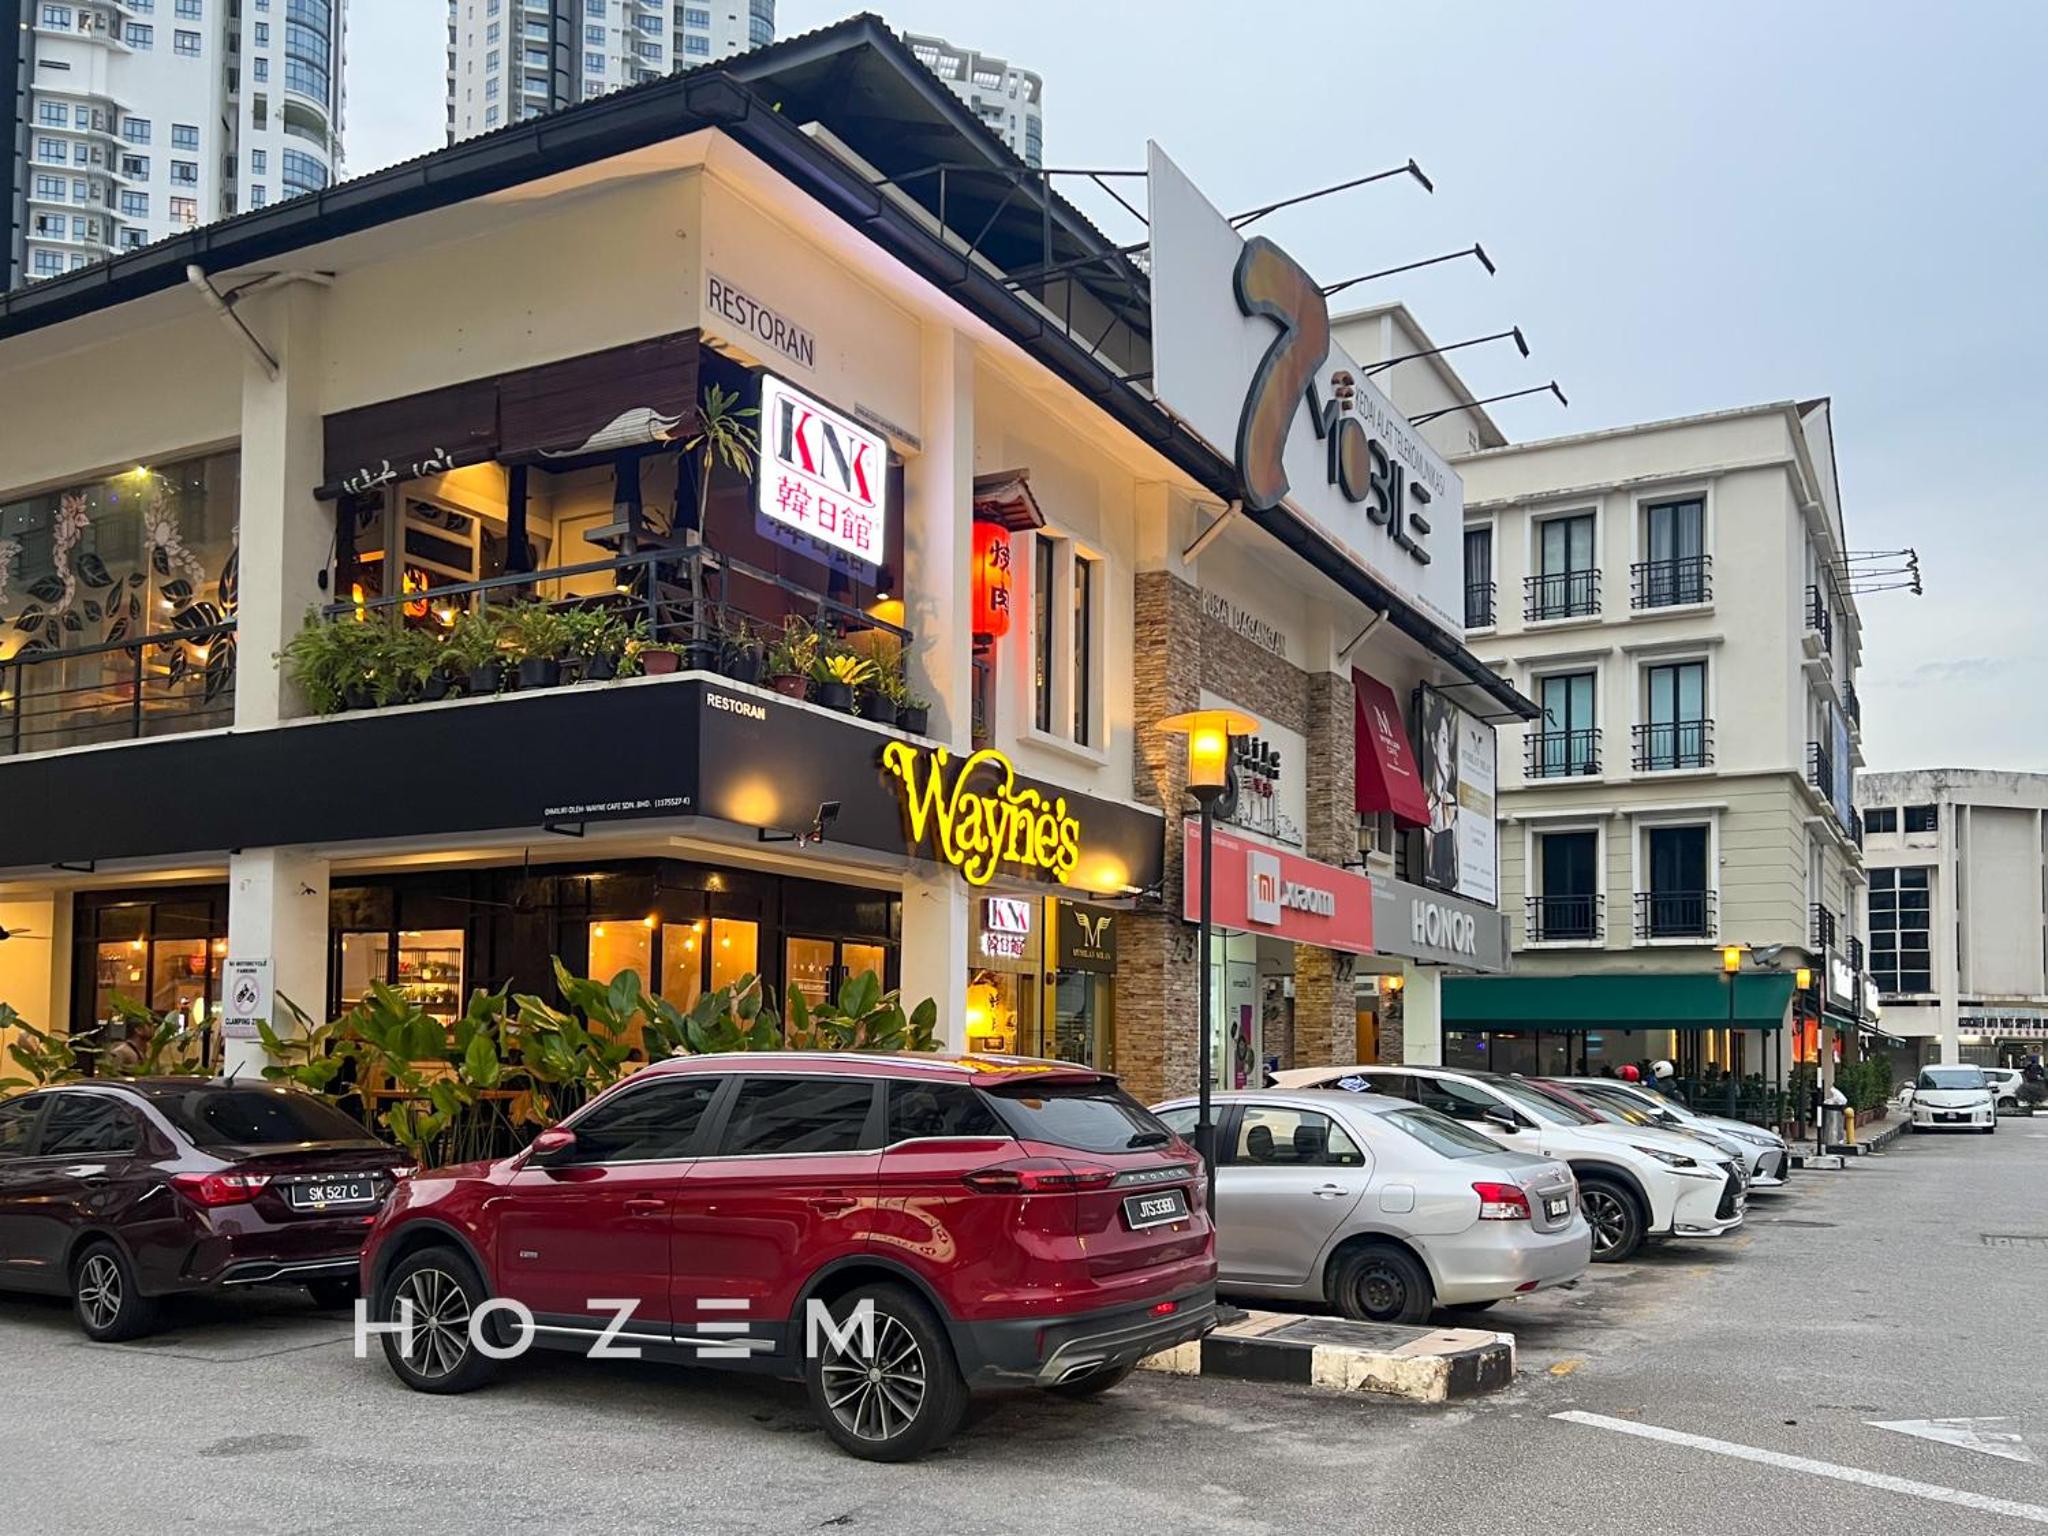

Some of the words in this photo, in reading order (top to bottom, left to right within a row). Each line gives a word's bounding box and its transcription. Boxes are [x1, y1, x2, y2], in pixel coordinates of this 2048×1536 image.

[709, 279, 815, 367] RESTORAN
[1233, 235, 1330, 511] 7
[778, 397, 874, 505] KNK
[776, 475, 874, 551] 韓日館
[706, 693, 766, 720] RESTORAN
[883, 741, 1080, 886] Wayne's
[1412, 898, 1477, 956] HONOR
[309, 1188, 325, 1201] SK
[327, 1185, 347, 1200] 527
[351, 1184, 359, 1197] C
